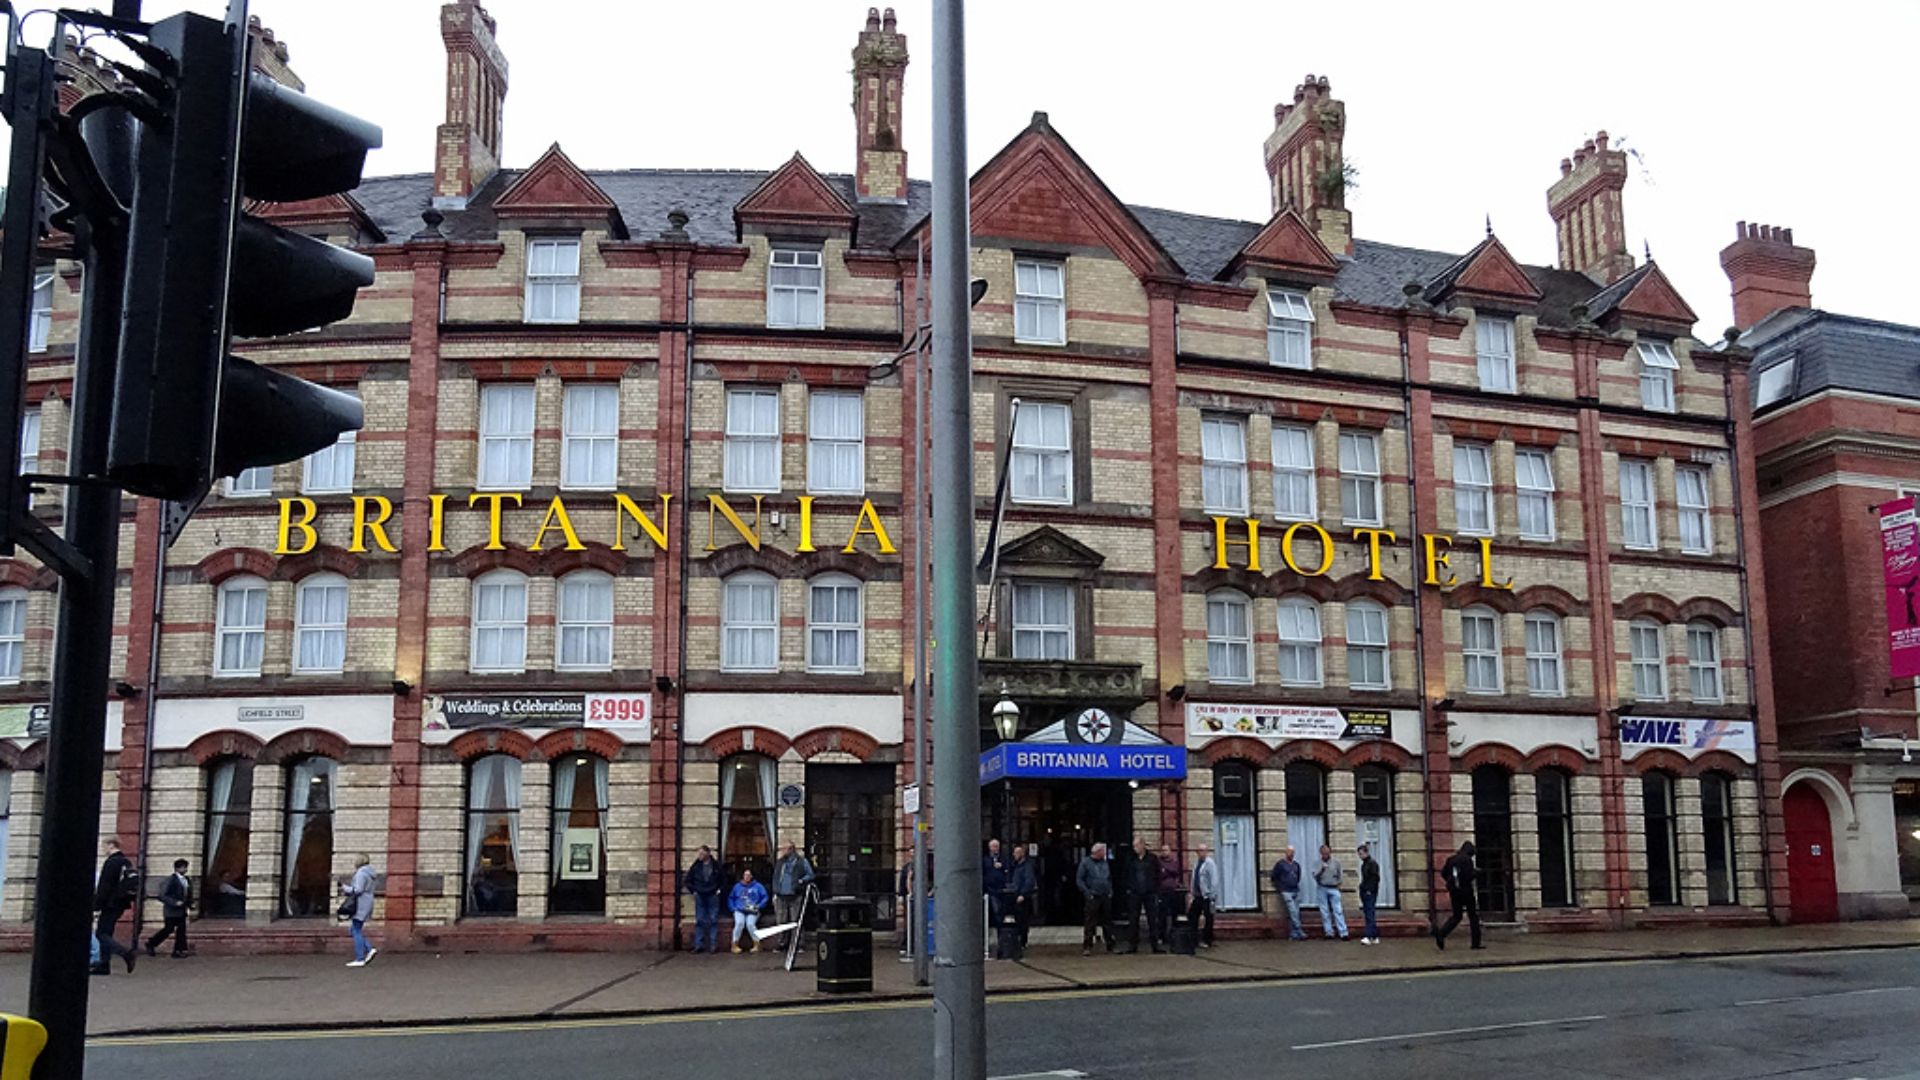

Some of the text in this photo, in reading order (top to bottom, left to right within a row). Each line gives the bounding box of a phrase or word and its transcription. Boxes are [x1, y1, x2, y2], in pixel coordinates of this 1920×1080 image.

[273, 493, 898, 555] BRITANNIA
[1212, 517, 1514, 590] HOTEL
[446, 700, 583, 715] Weddings & Celebrations
[590, 699, 645, 720] £999
[1621, 719, 1681, 744] WAVE
[1017, 752, 1175, 769] BRITANNIA HOTEL
